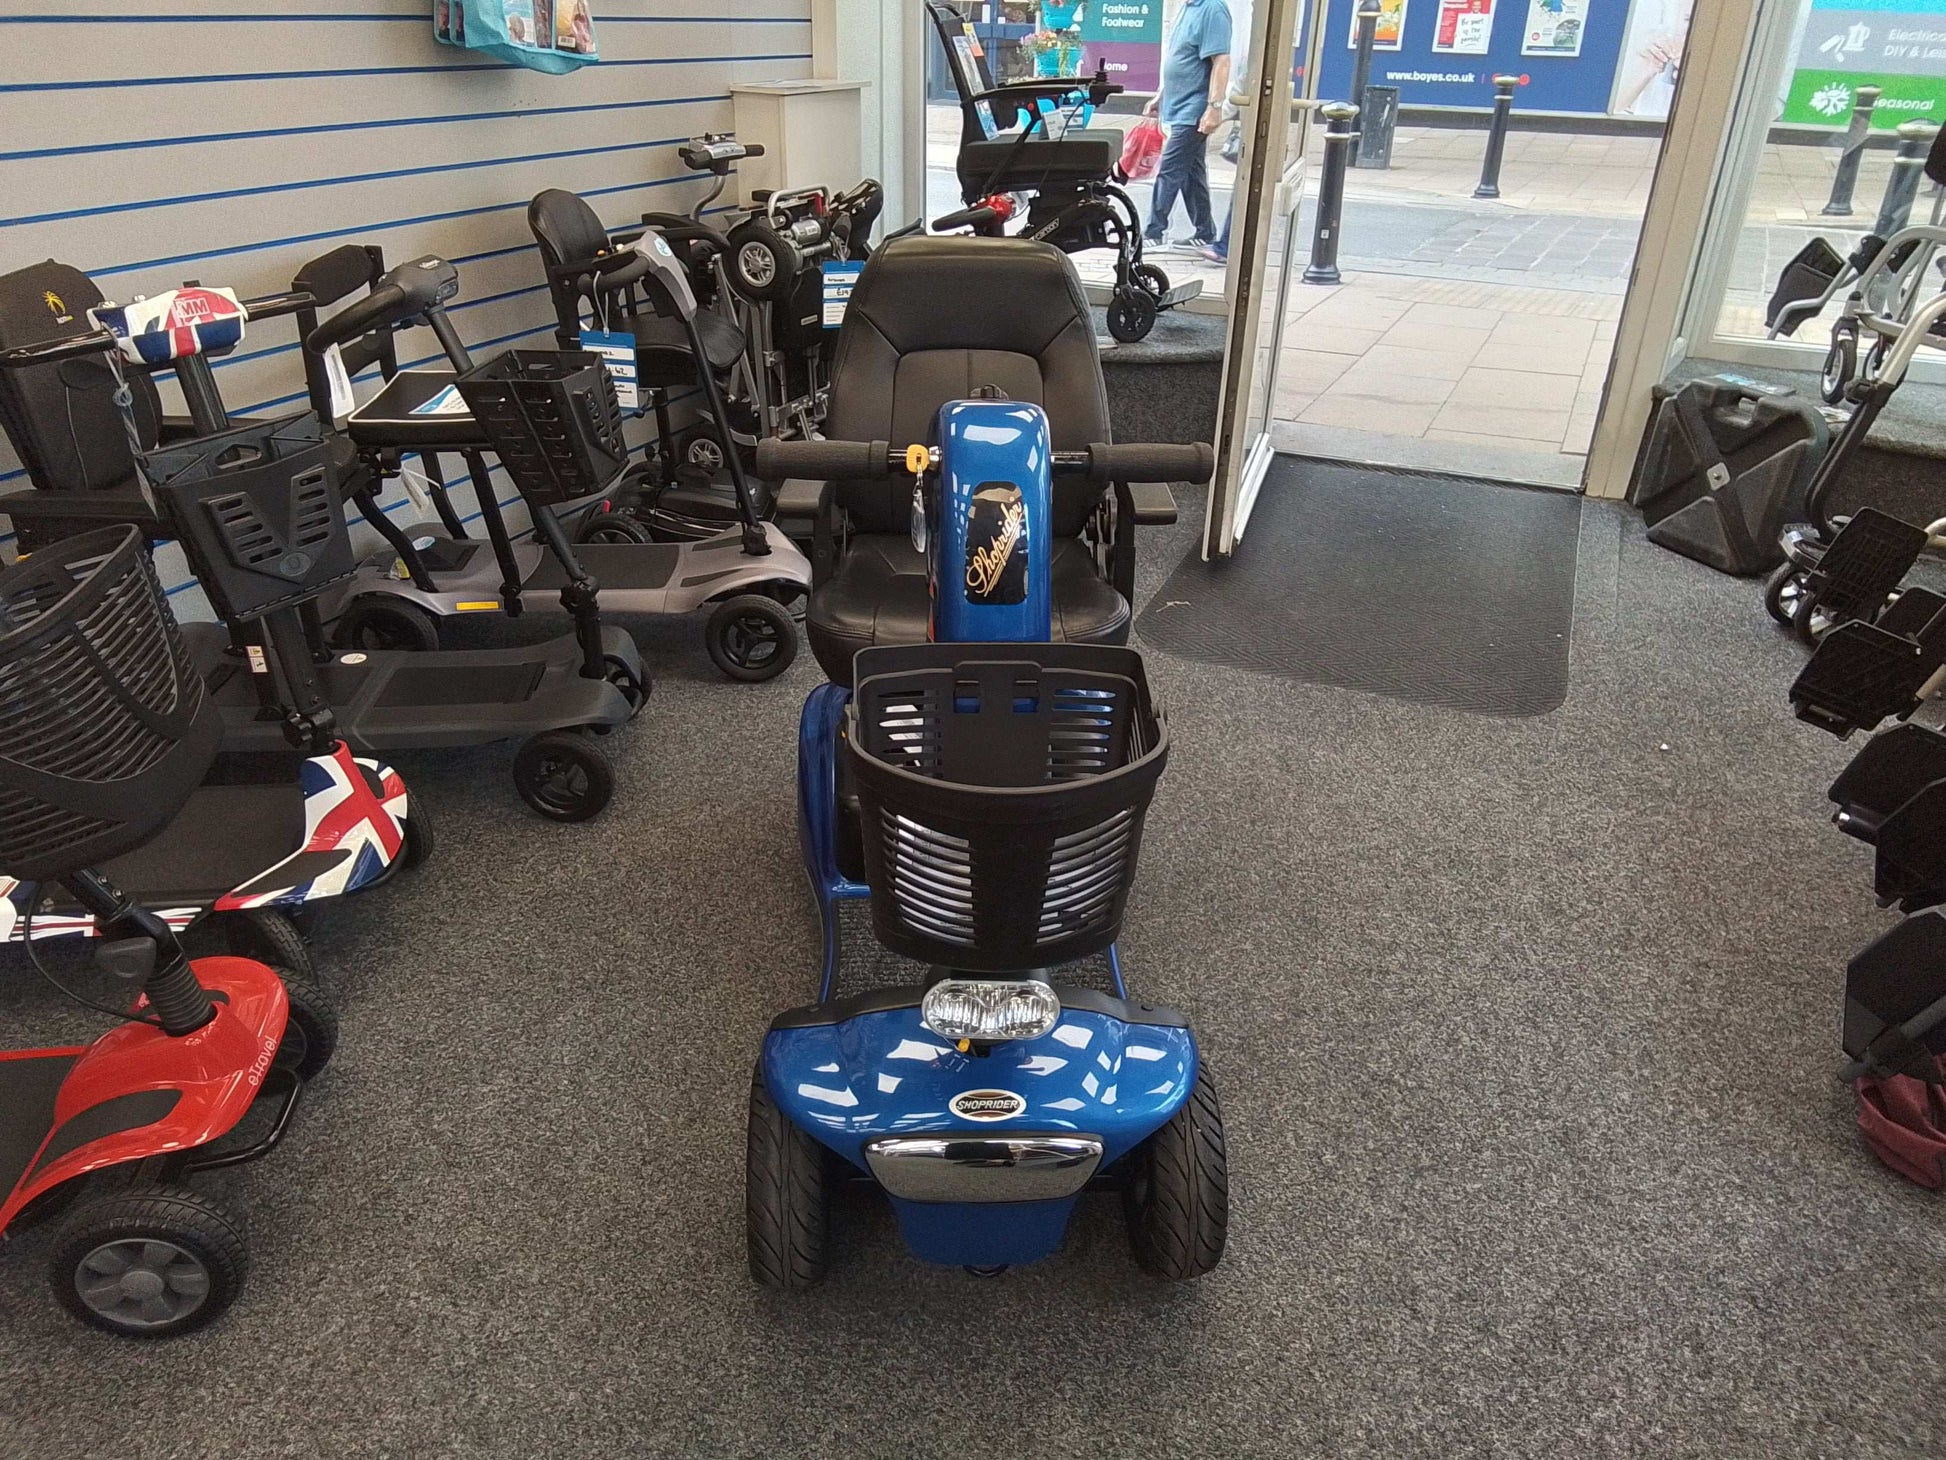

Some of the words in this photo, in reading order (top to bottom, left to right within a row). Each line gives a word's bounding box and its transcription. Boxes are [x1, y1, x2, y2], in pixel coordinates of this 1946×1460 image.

[1102, 3, 1139, 14] Fashion
[1141, 4, 1149, 14] &
[1101, 16, 1144, 27] Footwear
[1884, 44, 1908, 56] DIY
[1104, 62, 1128, 71] ome
[1386, 71, 1476, 83] www.boyes.co.uk
[966, 501, 1023, 595] Shoprider
[248, 1034, 277, 1086] eTravel
[957, 1100, 1018, 1110] SHOPRIDER
